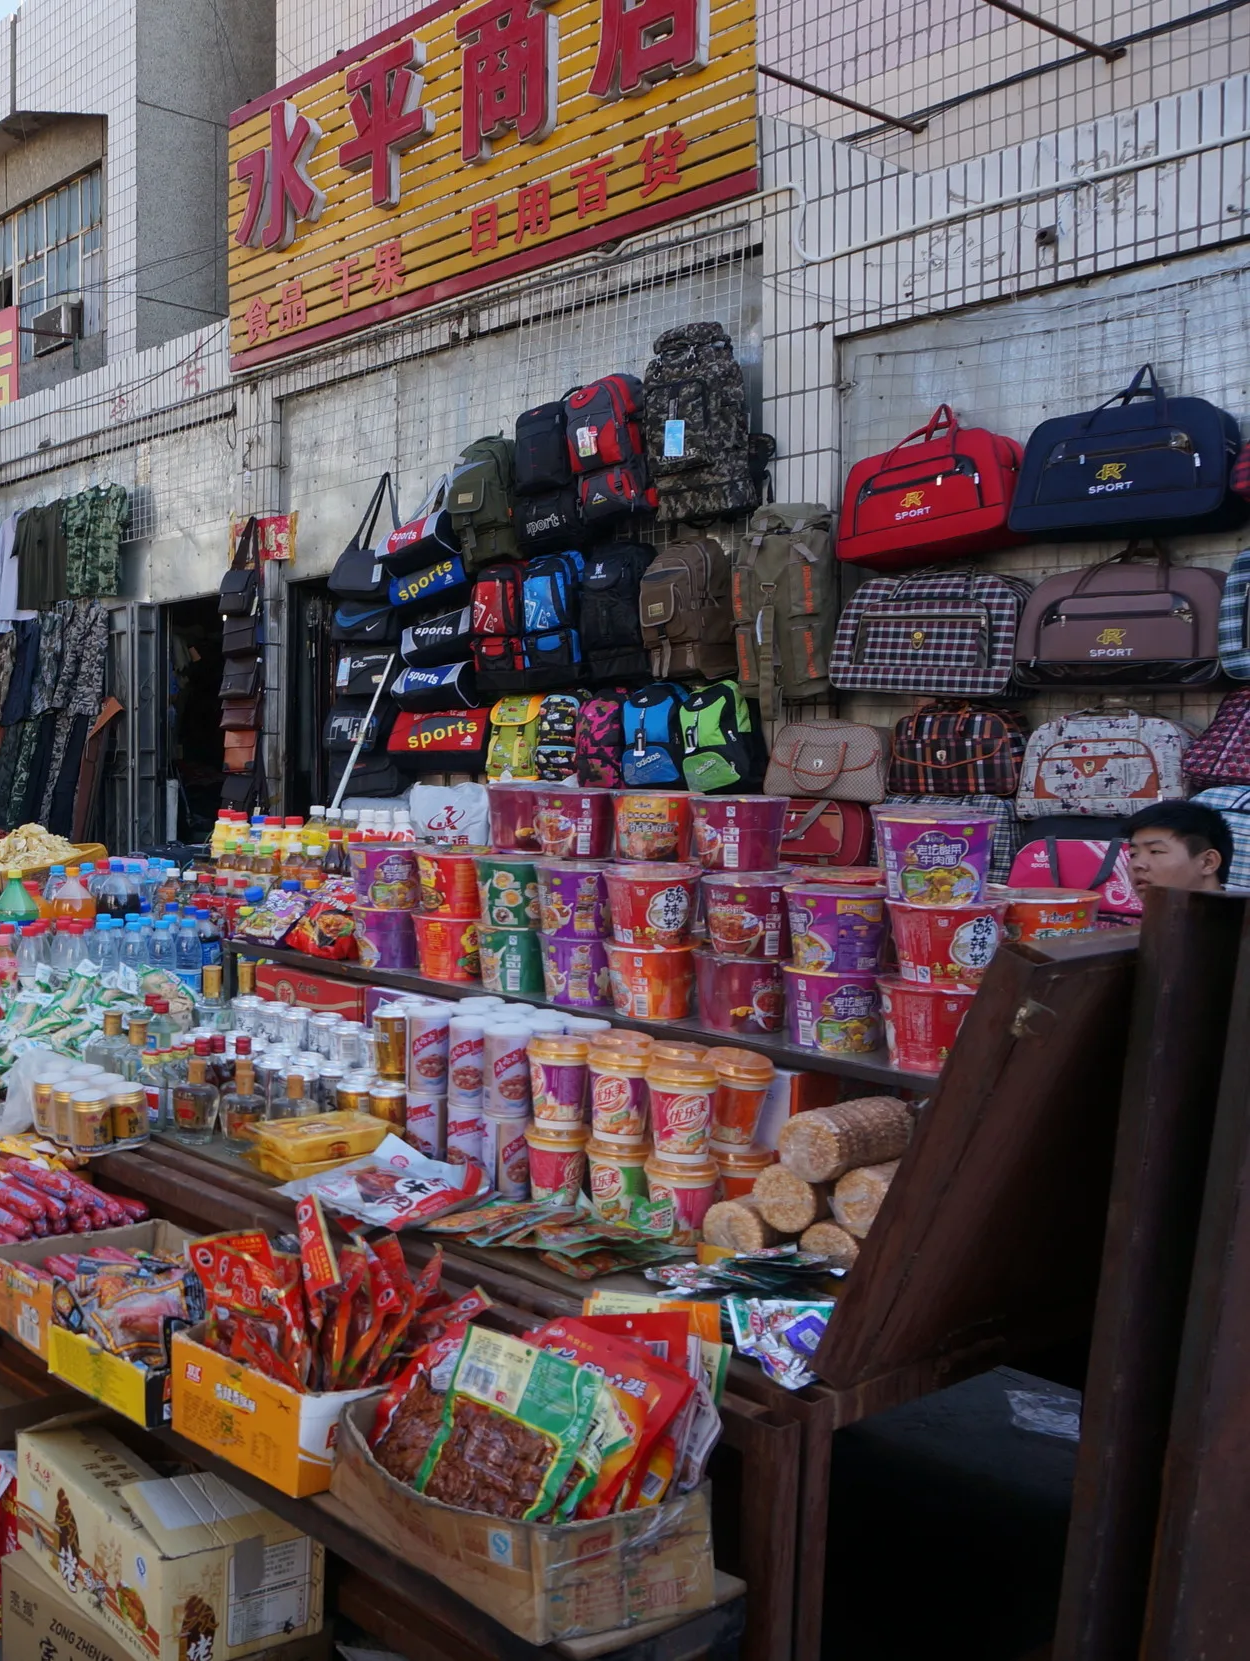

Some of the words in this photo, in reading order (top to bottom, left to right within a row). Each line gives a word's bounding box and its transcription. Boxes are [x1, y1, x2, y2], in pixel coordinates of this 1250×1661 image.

[234, 0, 708, 252] 水平商店
[243, 281, 308, 344] 食品
[330, 240, 406, 309] 干果
[470, 129, 688, 257] 日用百货
[1088, 480, 1133, 494] SPORT
[895, 506, 931, 520] SPORT
[391, 530, 417, 541] sports
[398, 560, 453, 602] sports
[414, 625, 453, 637] sports
[1089, 647, 1134, 658] SPORT
[407, 670, 440, 685] sports
[407, 720, 478, 749] sports
[636, 752, 661, 768] adidas
[916, 844, 962, 856] 老坛酸菜
[920, 855, 957, 866] 牛肉面
[662, 886, 684, 930] 酸辣粉
[969, 915, 995, 968] 酸辣粉
[669, 1100, 708, 1124] 优乐美
[49, 1618, 75, 1645] ZONG
[75, 1635, 105, 1657] ZHEN
